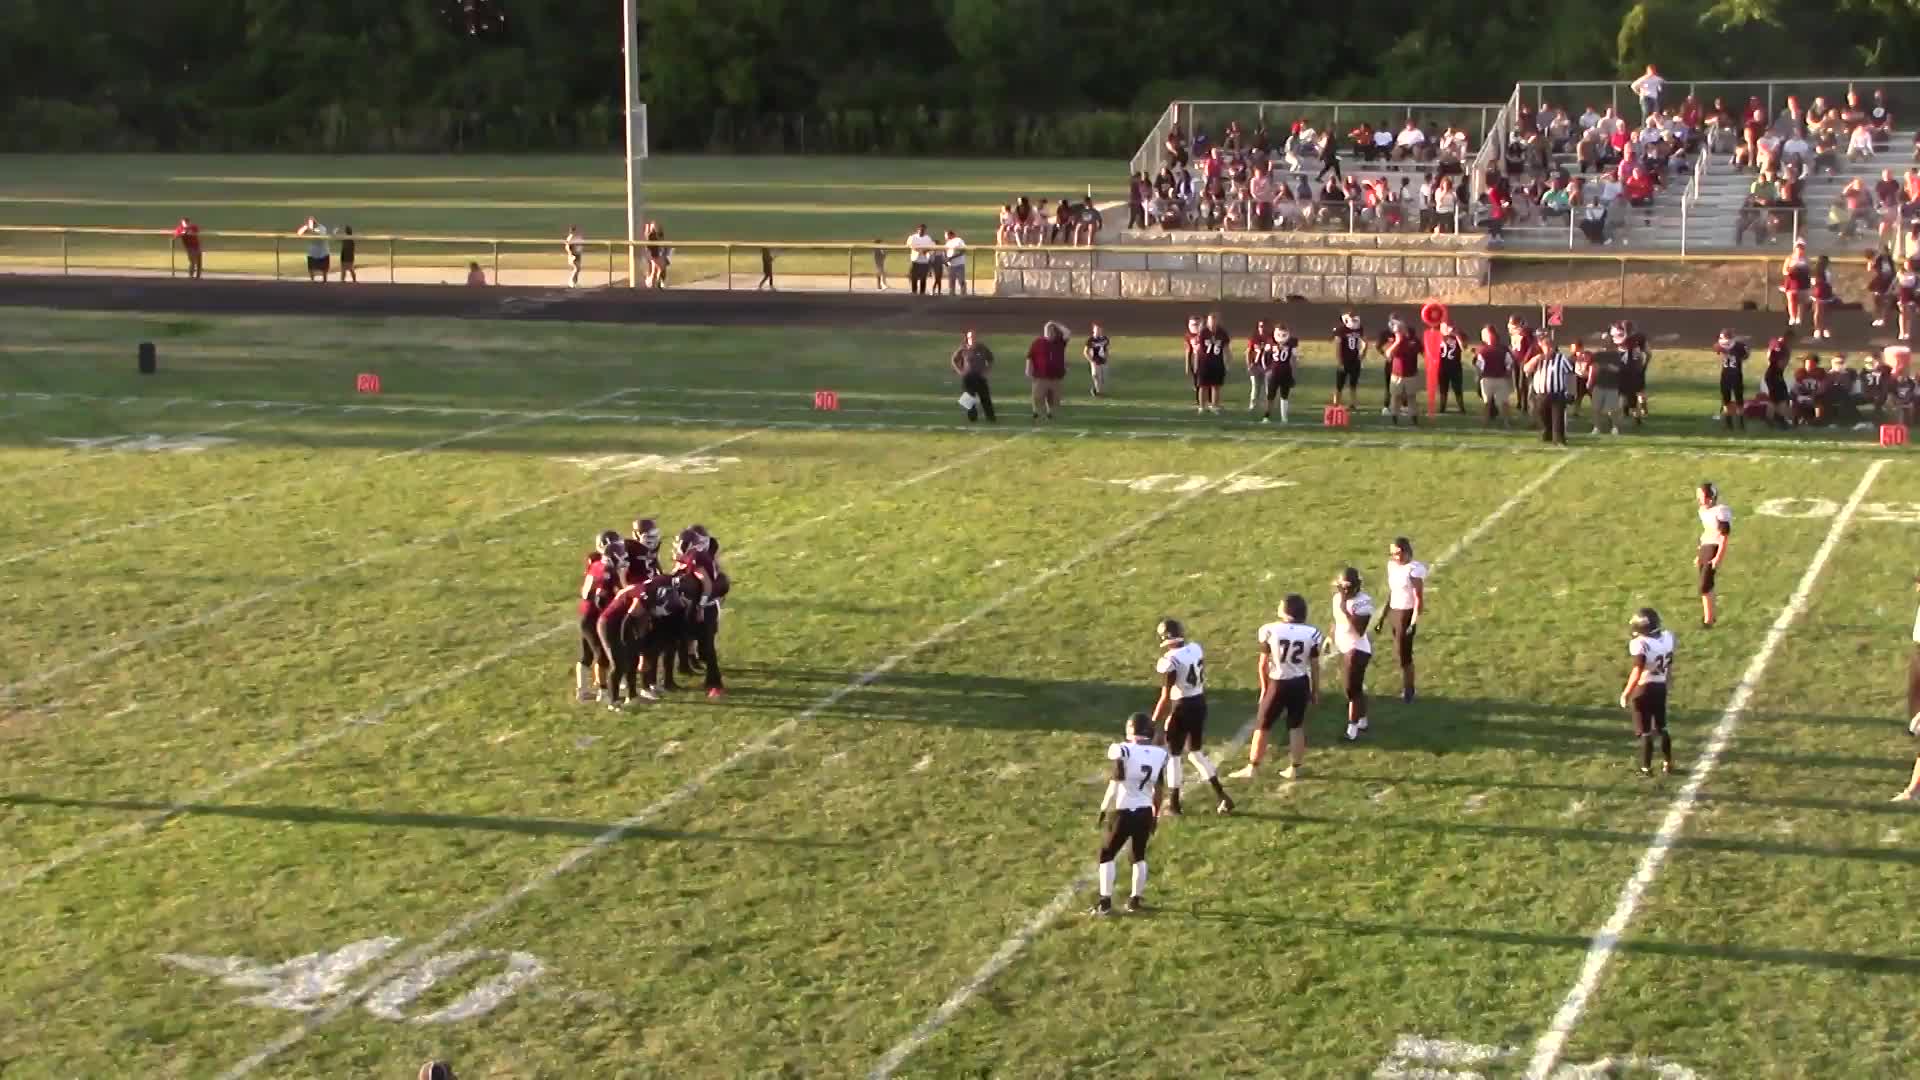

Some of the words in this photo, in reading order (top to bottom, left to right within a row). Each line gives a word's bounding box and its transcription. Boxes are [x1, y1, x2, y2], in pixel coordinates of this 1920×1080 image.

[1204, 339, 1222, 356] 76
[358, 374, 379, 392] 20
[815, 391, 836, 409] 30
[1325, 407, 1346, 425] 40
[1881, 425, 1905, 446] 50
[1278, 638, 1306, 665] 72
[1138, 764, 1153, 791] 7
